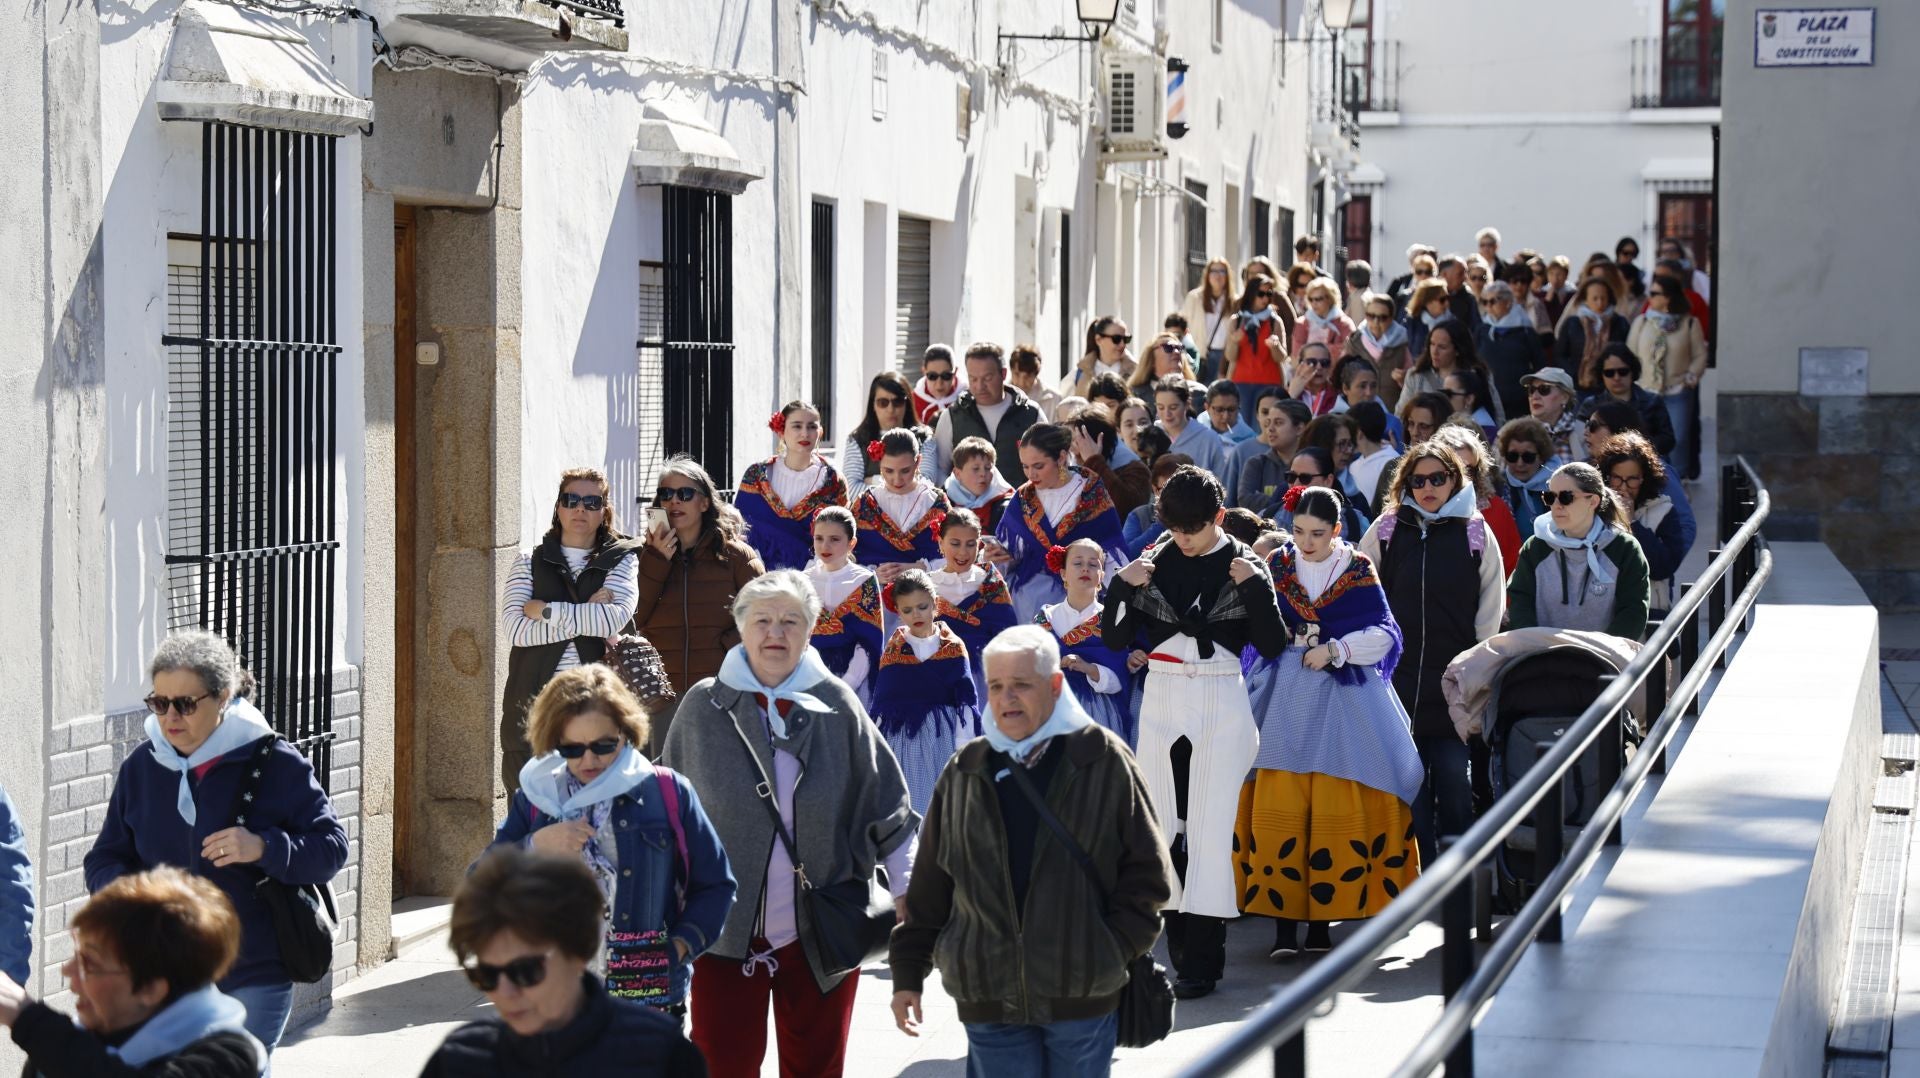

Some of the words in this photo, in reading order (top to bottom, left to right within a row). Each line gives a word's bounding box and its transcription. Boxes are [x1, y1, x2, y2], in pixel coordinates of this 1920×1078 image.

[1797, 16, 1848, 32] PLAZA
[1806, 36, 1818, 45] DE
[1820, 36, 1832, 44] LA
[1776, 44, 1859, 58] CONSTITUCIÓN
